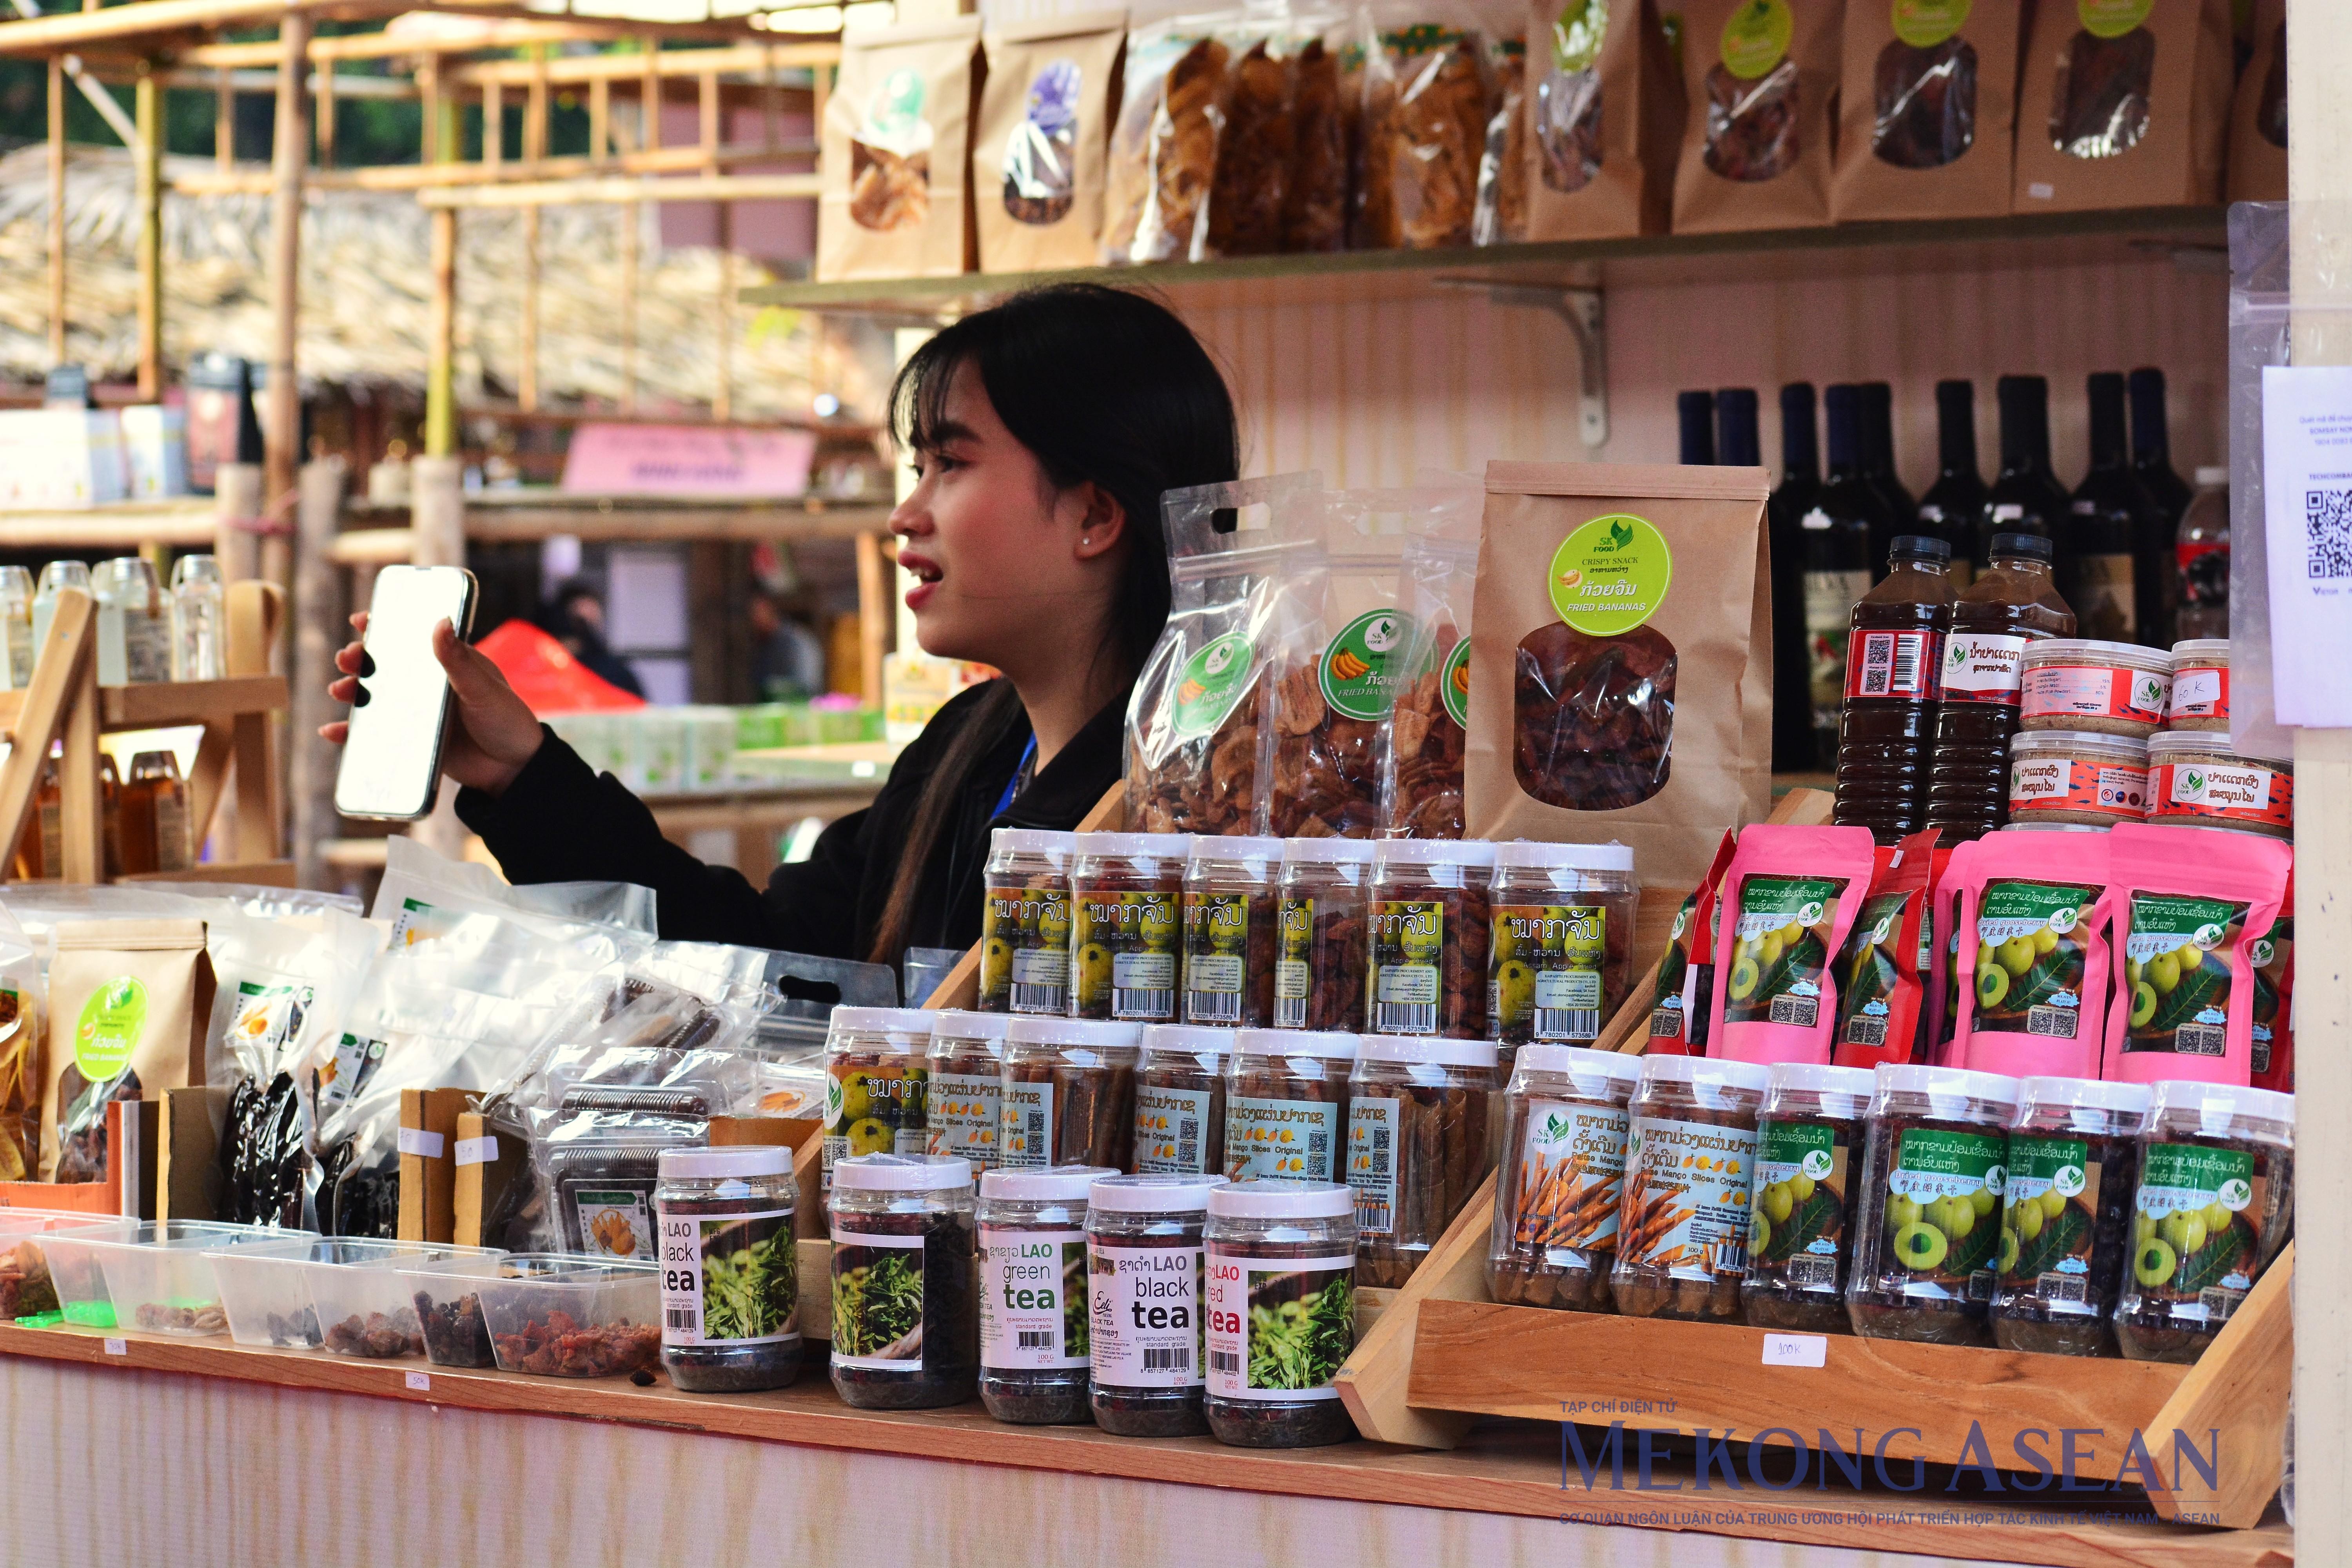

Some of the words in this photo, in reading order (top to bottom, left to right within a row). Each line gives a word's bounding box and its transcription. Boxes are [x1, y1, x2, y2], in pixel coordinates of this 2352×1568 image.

[1567, 603, 1595, 612] FRIED
[1597, 603, 1646, 611] BANANAS
[1338, 688, 1364, 697] FRIED
[2179, 685, 2188, 701] 60
[2194, 681, 2205, 694] K
[1090, 896, 1174, 924] ໝາກຈັນ
[1511, 909, 1600, 940] ໝາກຈັນ
[2000, 920, 2046, 929] gooseberry
[946, 1117, 963, 1126] Slices
[967, 1119, 993, 1127] Original
[1152, 1132, 1175, 1142] Original
[1537, 1129, 1549, 1137] SK
[1232, 1143, 1248, 1152] Mango
[1275, 1146, 1303, 1156] Original
[1572, 1151, 1595, 1161] Pakse
[1599, 1155, 1623, 1167] Mango
[1662, 1169, 1687, 1180] Mango
[1691, 1173, 1715, 1183] Slices
[1720, 1177, 1748, 1189] Original
[1895, 1171, 1921, 1180] Dried
[1925, 1173, 1982, 1187] gooseberry
[668, 1222, 691, 1238] LAO
[662, 1242, 694, 1262] black
[990, 1246, 1019, 1263] ຊາຂຽວ
[1021, 1243, 1053, 1258] LAO
[1003, 1265, 1051, 1284] green
[1119, 1256, 1151, 1274] ຊາດຳ
[1154, 1256, 1187, 1272] LAO
[1216, 1264, 1240, 1281] LAO
[661, 1264, 695, 1292] tea
[1136, 1276, 1190, 1298] black
[1003, 1284, 1055, 1310] tea
[1208, 1284, 1223, 1303] red
[1131, 1301, 1190, 1329] tea
[1207, 1304, 1240, 1334] tea
